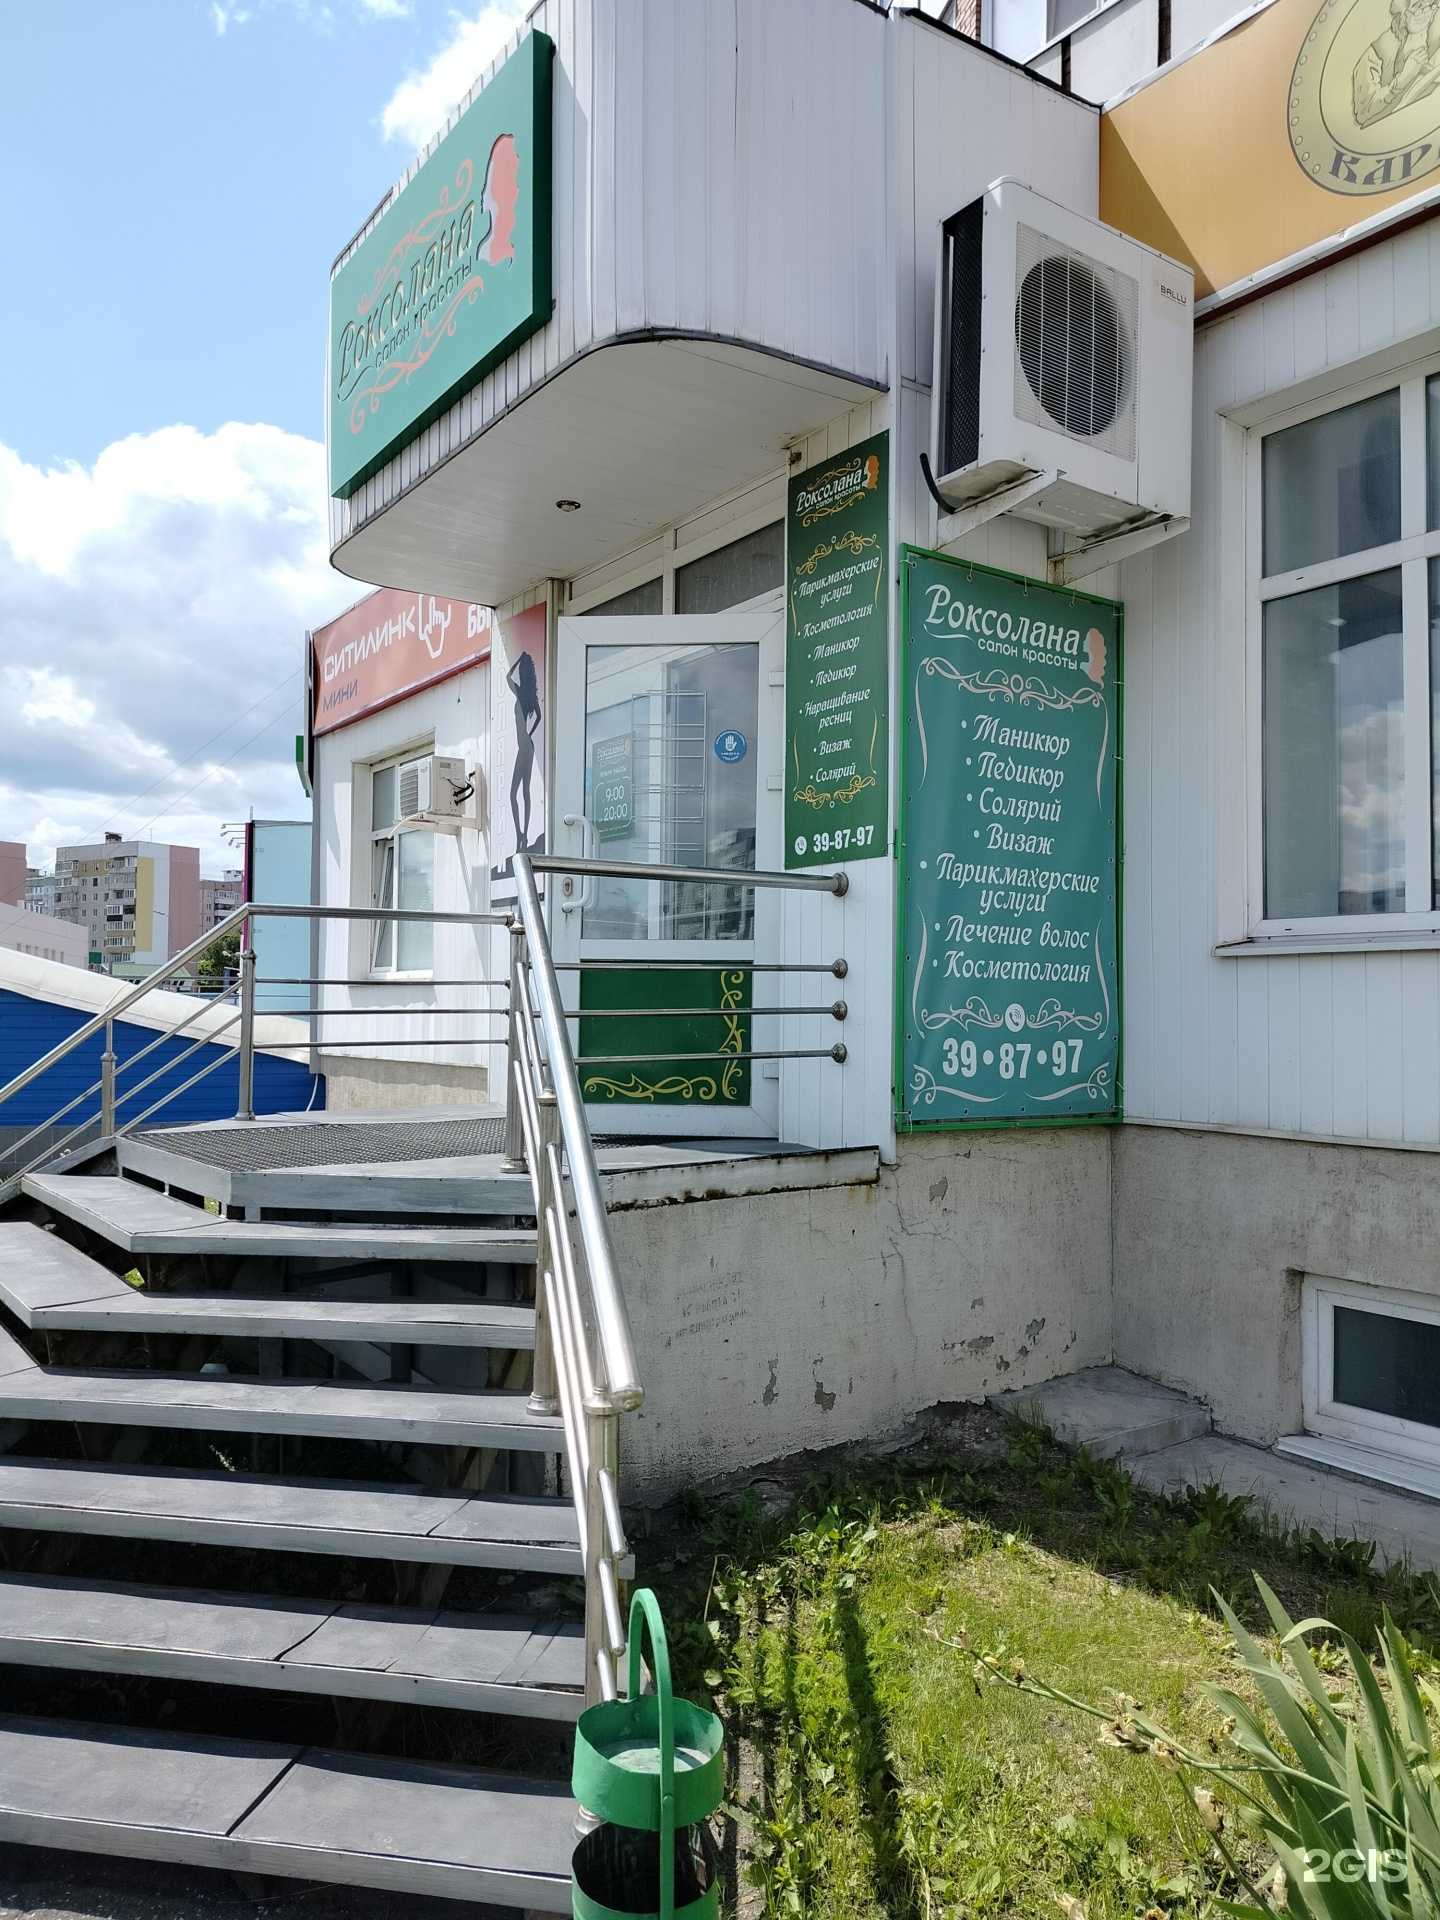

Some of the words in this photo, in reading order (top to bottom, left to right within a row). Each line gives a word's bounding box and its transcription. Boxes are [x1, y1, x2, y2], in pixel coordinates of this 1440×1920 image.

[1328, 143, 1440, 185] КАР
[338, 200, 474, 388] Роксолана
[796, 469, 862, 513] Роксолана
[815, 497, 834, 509] салон
[834, 484, 861, 500] красоты
[798, 556, 880, 599] Парикмахерские
[820, 583, 853, 608] услуги
[803, 602, 873, 639] Косметология
[924, 584, 1080, 656] Роксолана
[323, 605, 416, 682] СИТИЛИНК
[813, 635, 860, 661] Маникюр
[977, 637, 1018, 658] салон
[1022, 647, 1078, 671] красоты
[815, 664, 857, 687] Педикюр
[804, 688, 871, 717] Наращивание
[818, 709, 853, 737] ресниц
[972, 714, 1070, 760] Маникюр
[818, 738, 853, 756] Визаж
[815, 763, 856, 783] Солярий
[977, 751, 1064, 794] Педикюр
[979, 787, 1062, 825] Солярий
[813, 825, 875, 852] 39-87-97
[986, 823, 1055, 855] Визаж
[936, 853, 1100, 895] Парикмахерские
[979, 889, 1048, 917] услуги
[944, 915, 1032, 946] Лечение
[1039, 921, 1090, 949] волос
[943, 950, 1091, 983] Косметология
